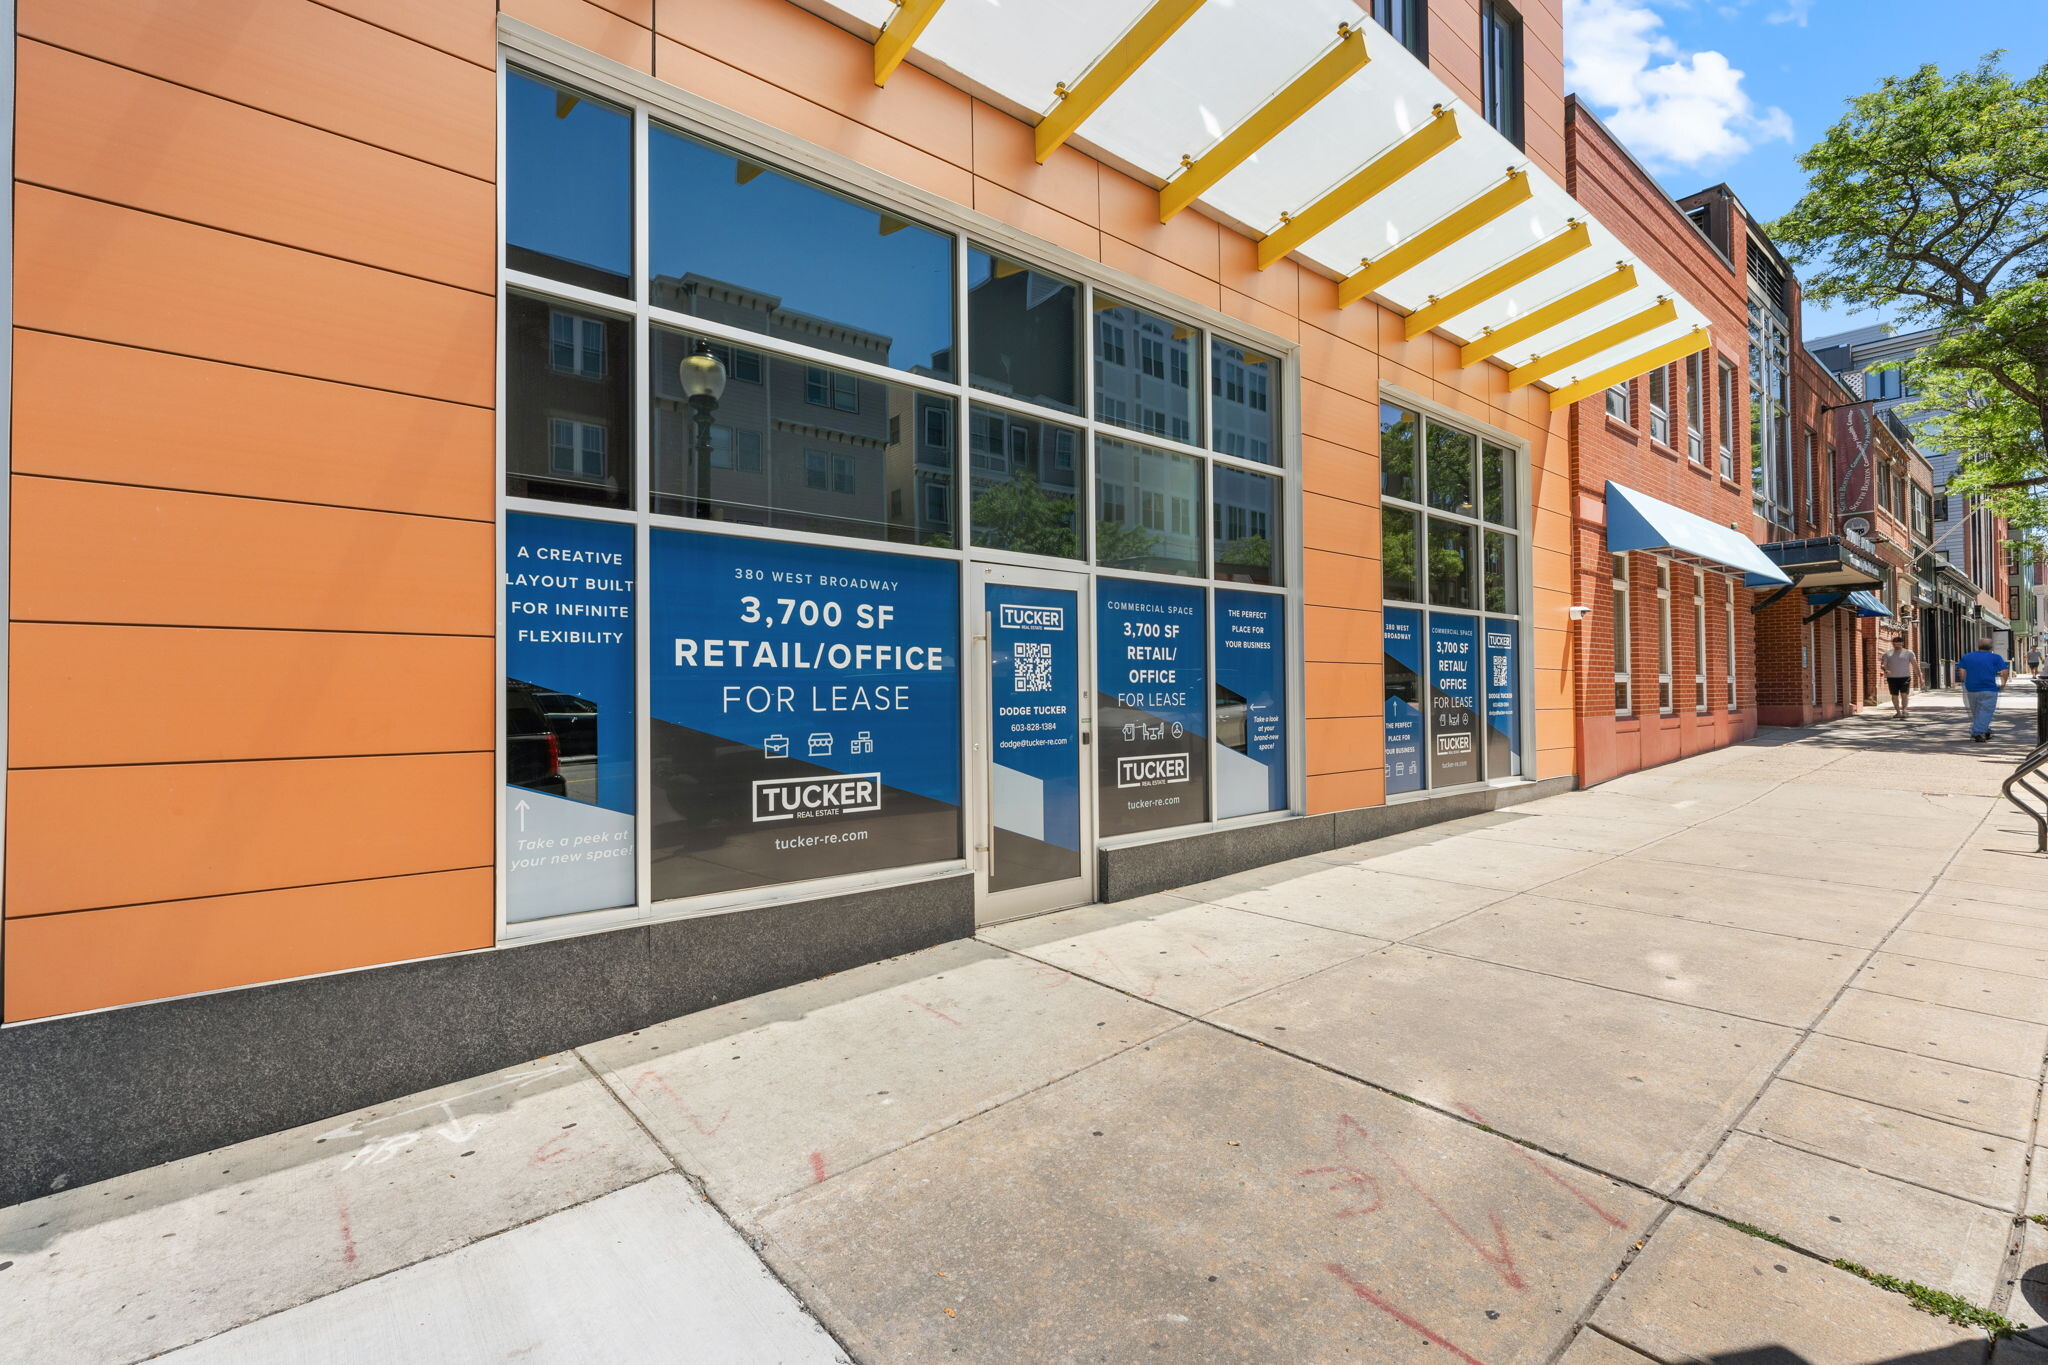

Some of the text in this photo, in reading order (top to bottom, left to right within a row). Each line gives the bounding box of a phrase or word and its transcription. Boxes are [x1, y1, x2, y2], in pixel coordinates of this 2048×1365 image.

[517, 546, 623, 566] A CREATIVE
[505, 573, 634, 592] LAYOUT BUILT
[734, 568, 900, 592] 380 WEST BROADWAY
[511, 601, 629, 618] FOR INFINITE
[740, 595, 895, 630] 3,700 SF
[1107, 601, 1193, 615] COMMERCIAL SPACE
[1228, 609, 1267, 619] THE PERFECT
[1005, 609, 1059, 626] TUCKER
[518, 629, 623, 644] FLEXIBILITY
[1123, 622, 1180, 639] 3,700 SF
[1231, 625, 1264, 634] PLACE FOR
[1225, 640, 1271, 649] YOUR BUSINESS
[1436, 641, 1469, 654] 3,700 SF
[1489, 636, 1511, 646] TUCKER
[674, 638, 943, 671] RETAIL/OFFICE
[1127, 646, 1177, 661] RETAIL/
[1438, 660, 1468, 672] RETAIL/
[1129, 669, 1176, 684] OFFICE
[1440, 678, 1467, 690] OFFICE
[723, 685, 910, 714] FOR LEASE
[1118, 692, 1186, 707] FOR LEASE
[1433, 696, 1473, 709] FOR LEASE
[999, 705, 1067, 716] DODGE TUCKER
[1253, 715, 1265, 723] Take
[1011, 722, 1057, 732] 603-828-1384
[1264, 725, 1275, 733] your
[999, 738, 1068, 749] dodge@tucker-re.com
[1253, 733, 1279, 742] brand-new
[1439, 737, 1469, 751] TUCKER
[1259, 742, 1275, 751] space!
[1123, 759, 1185, 781] TUCKER
[762, 781, 873, 812] TUCKER
[1127, 796, 1180, 810] tucker-re.com
[796, 808, 840, 819] REAL ESTATE
[517, 830, 628, 851] Take a peek at
[775, 831, 869, 850] tucker-re.com
[510, 845, 633, 872] your new space!
